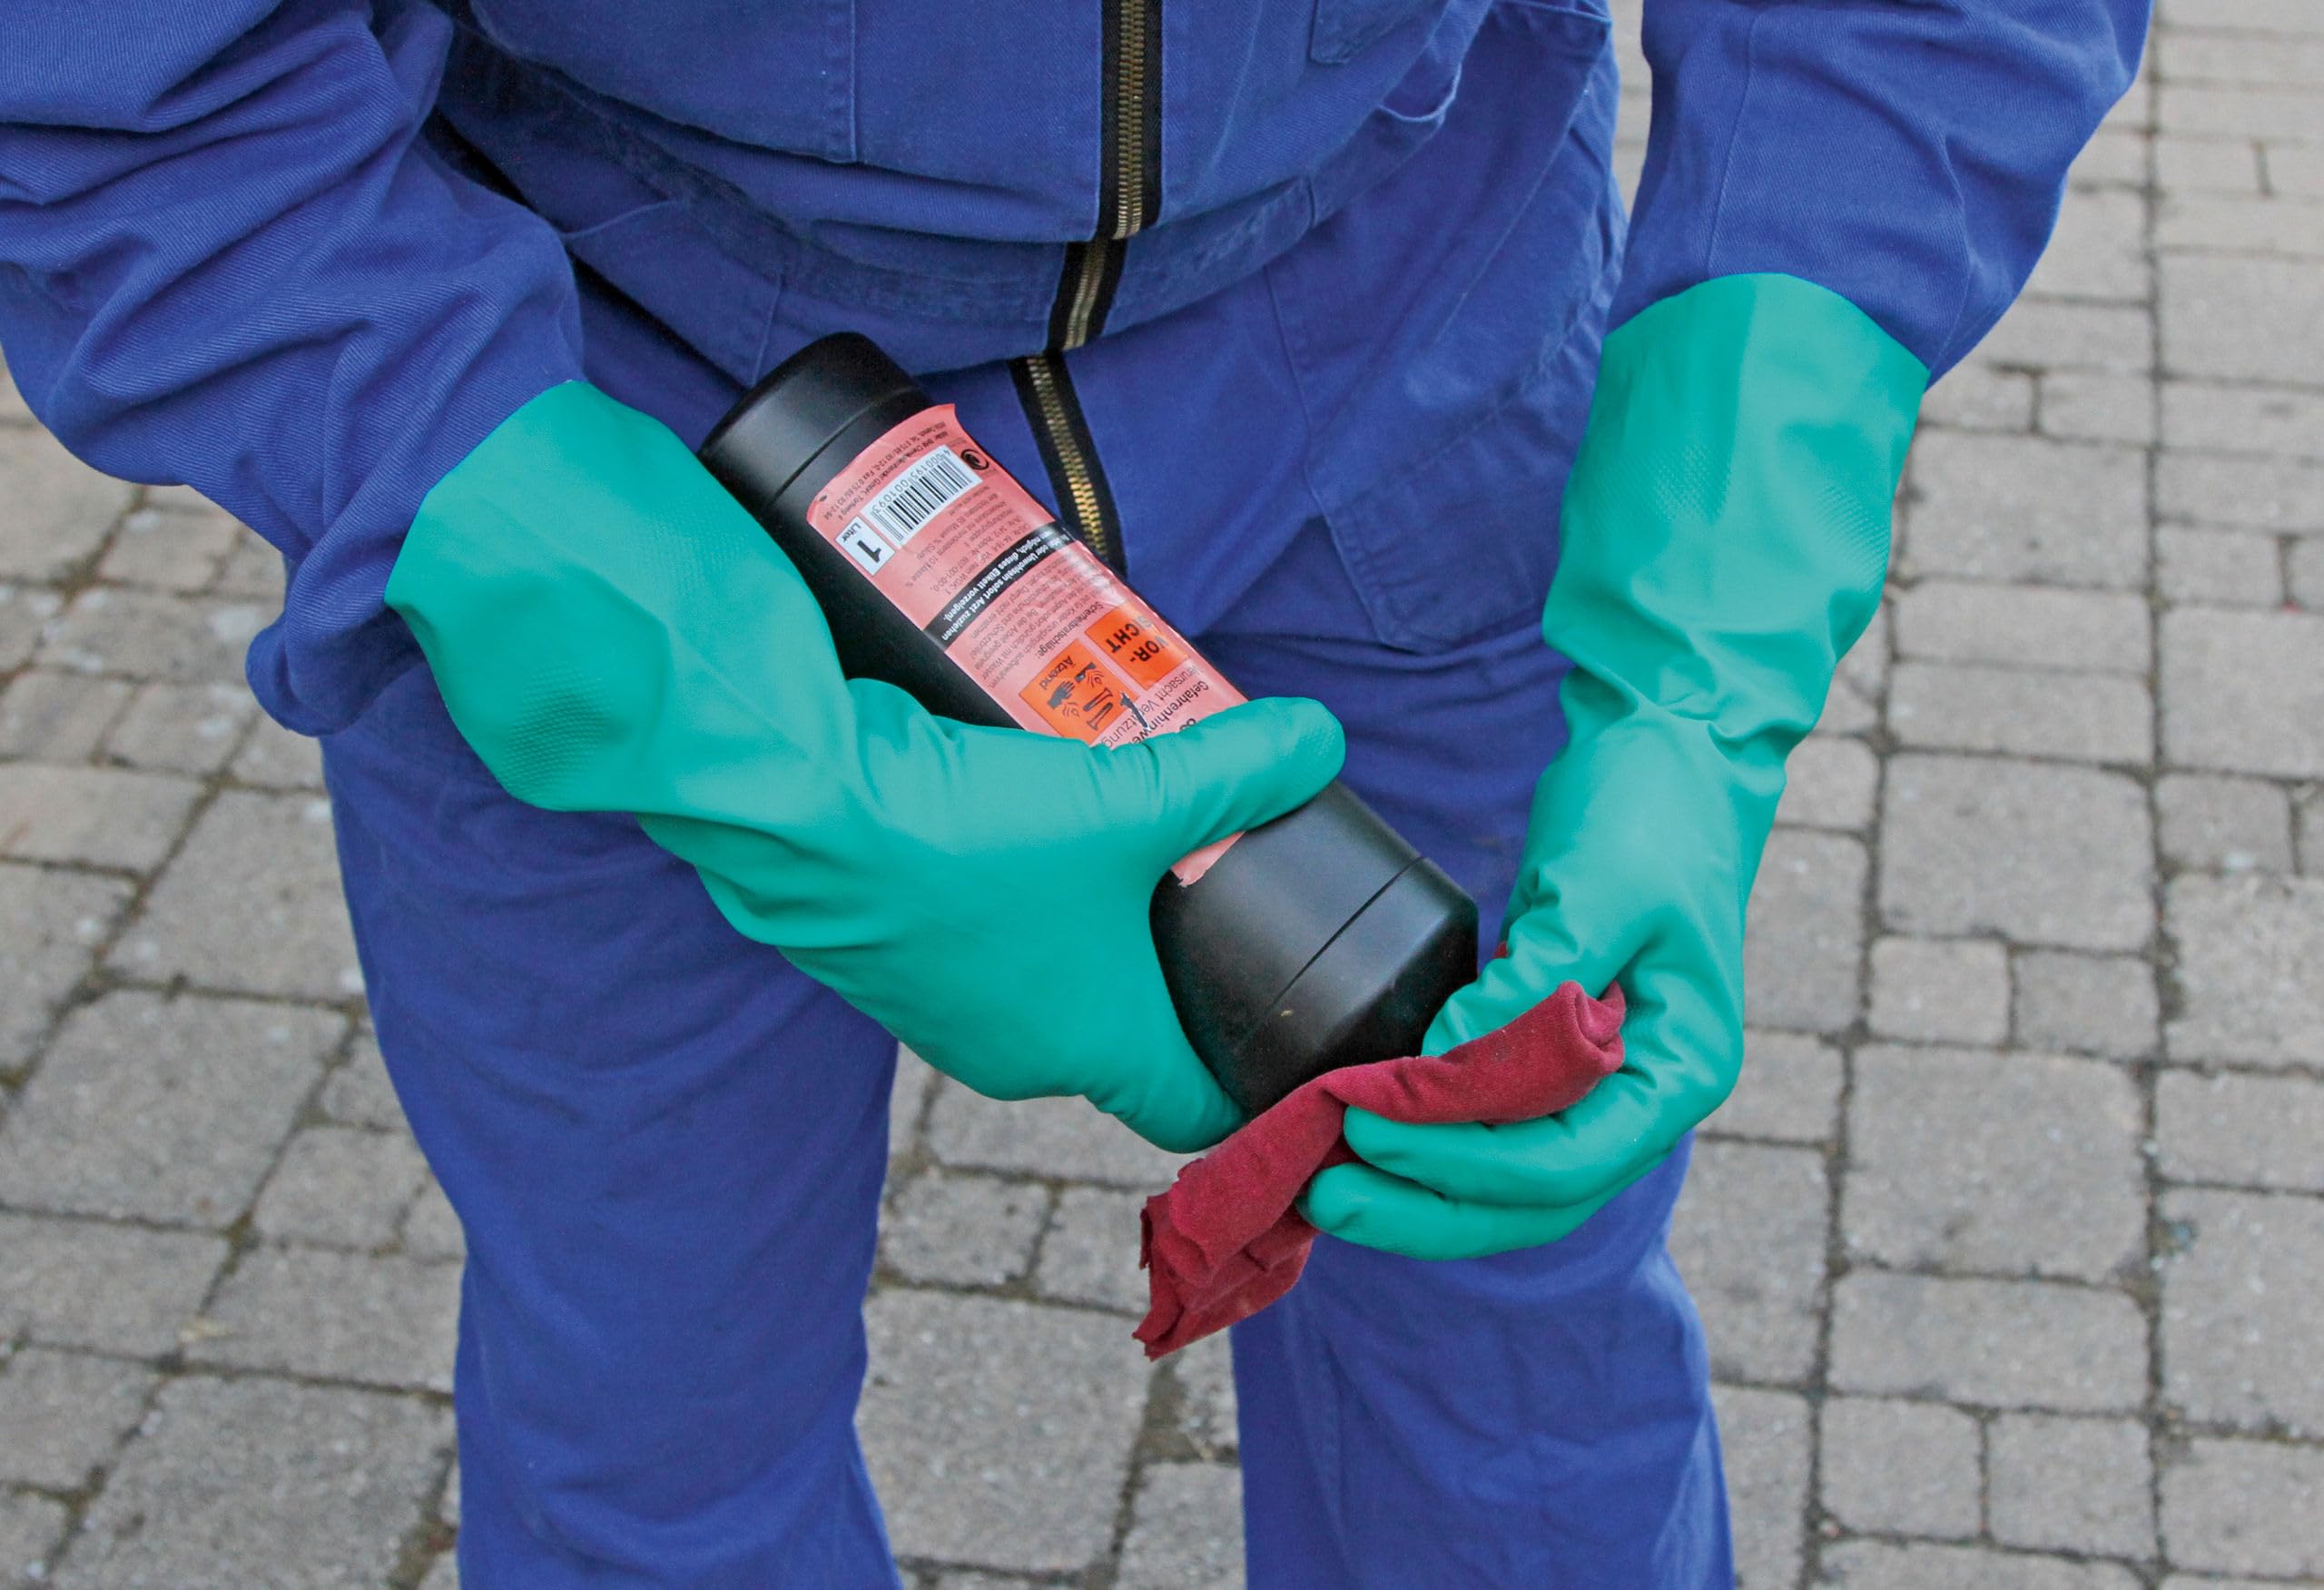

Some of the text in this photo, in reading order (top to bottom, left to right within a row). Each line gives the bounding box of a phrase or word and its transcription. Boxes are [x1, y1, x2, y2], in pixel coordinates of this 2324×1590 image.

[862, 469, 874, 481] Fax
[909, 452, 943, 480] 000195
[871, 478, 909, 515] 001093
[840, 521, 861, 543] Liter
[856, 539, 881, 562] 1
[997, 551, 1019, 571] dieses
[1034, 543, 1049, 557] oder
[976, 567, 1000, 590] Etikett
[1000, 551, 1038, 583] Unwohlsein
[981, 578, 1005, 600] sofort
[941, 585, 980, 624] vorzeigen).
[969, 596, 986, 614] Arzt
[940, 609, 971, 642] zuziehen
[1103, 612, 1152, 654] SICHT
[1127, 632, 1168, 668] VOR-
[980, 656, 1004, 680] Wasser
[1038, 655, 1076, 690] Ätzend
[1100, 696, 1159, 749] Vertzung
[1128, 678, 1209, 746] Gefahrenhinwe
